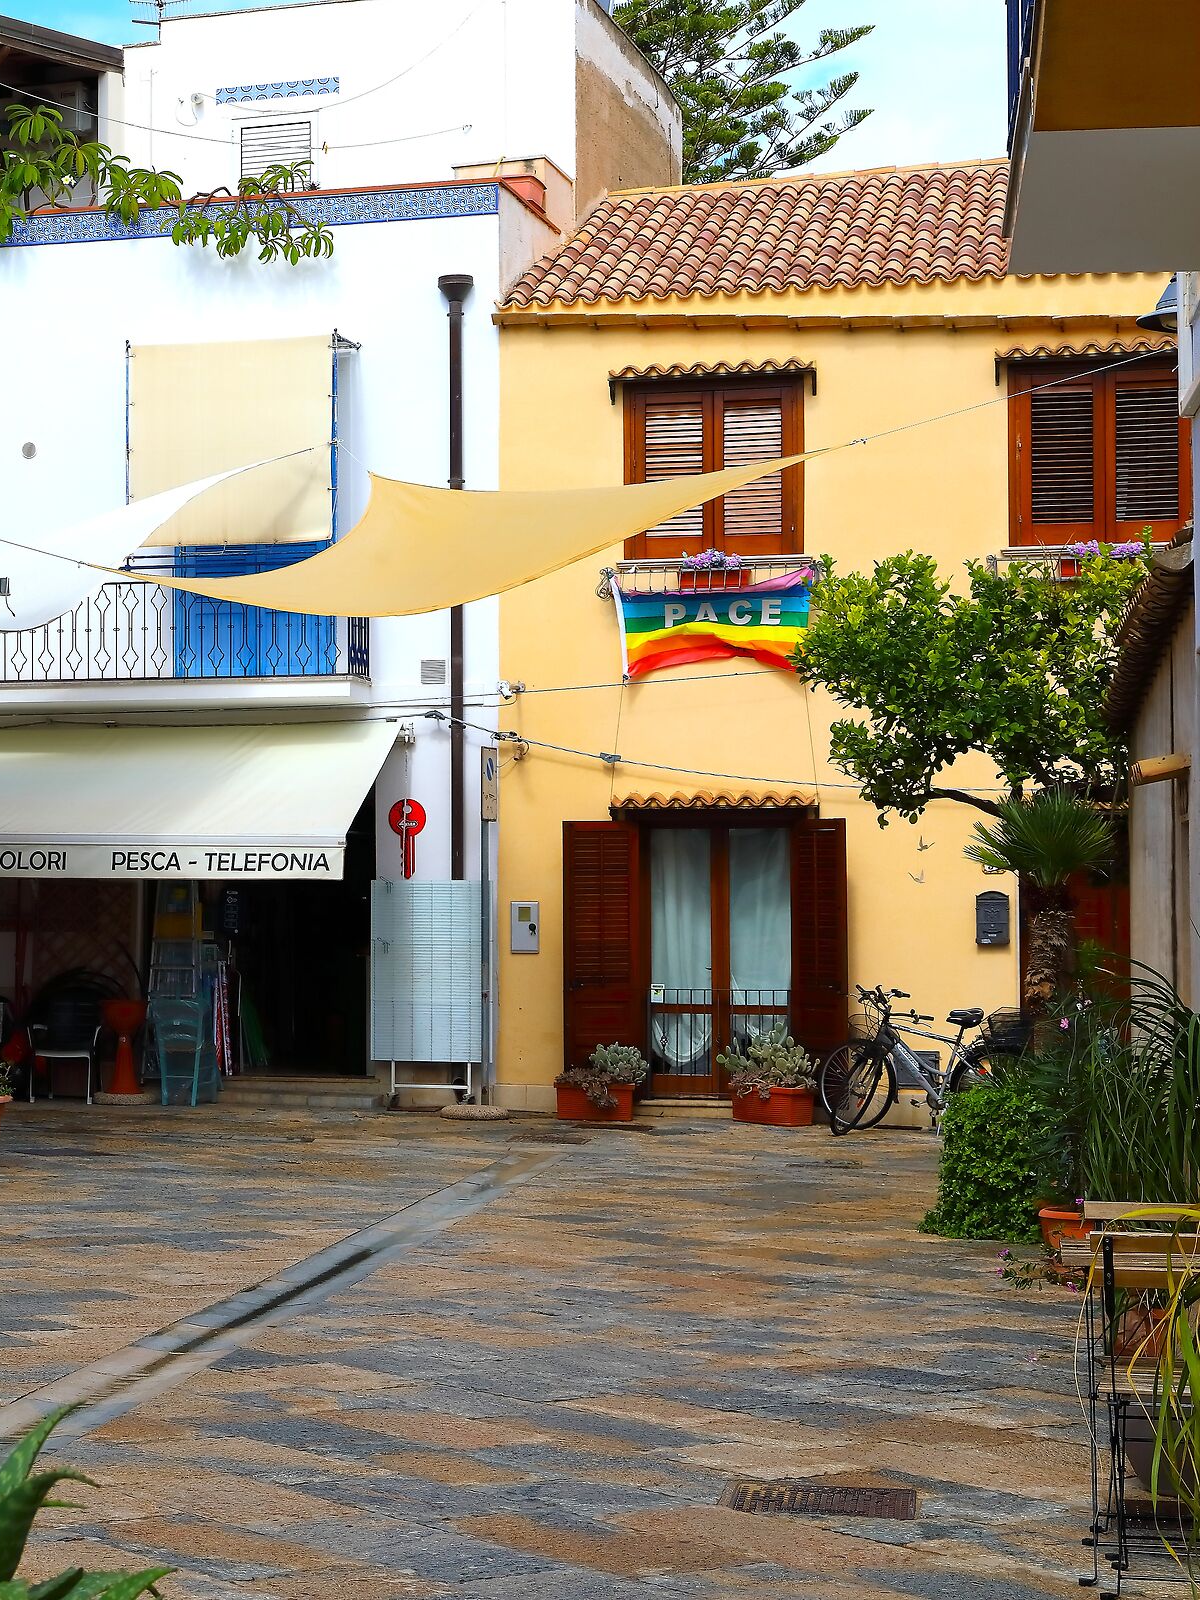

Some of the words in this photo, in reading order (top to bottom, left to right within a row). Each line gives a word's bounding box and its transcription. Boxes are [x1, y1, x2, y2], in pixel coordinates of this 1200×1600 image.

[664, 599, 782, 628] PACE
[111, 851, 181, 871] PESCA
[204, 851, 330, 872] TELEFONIA
